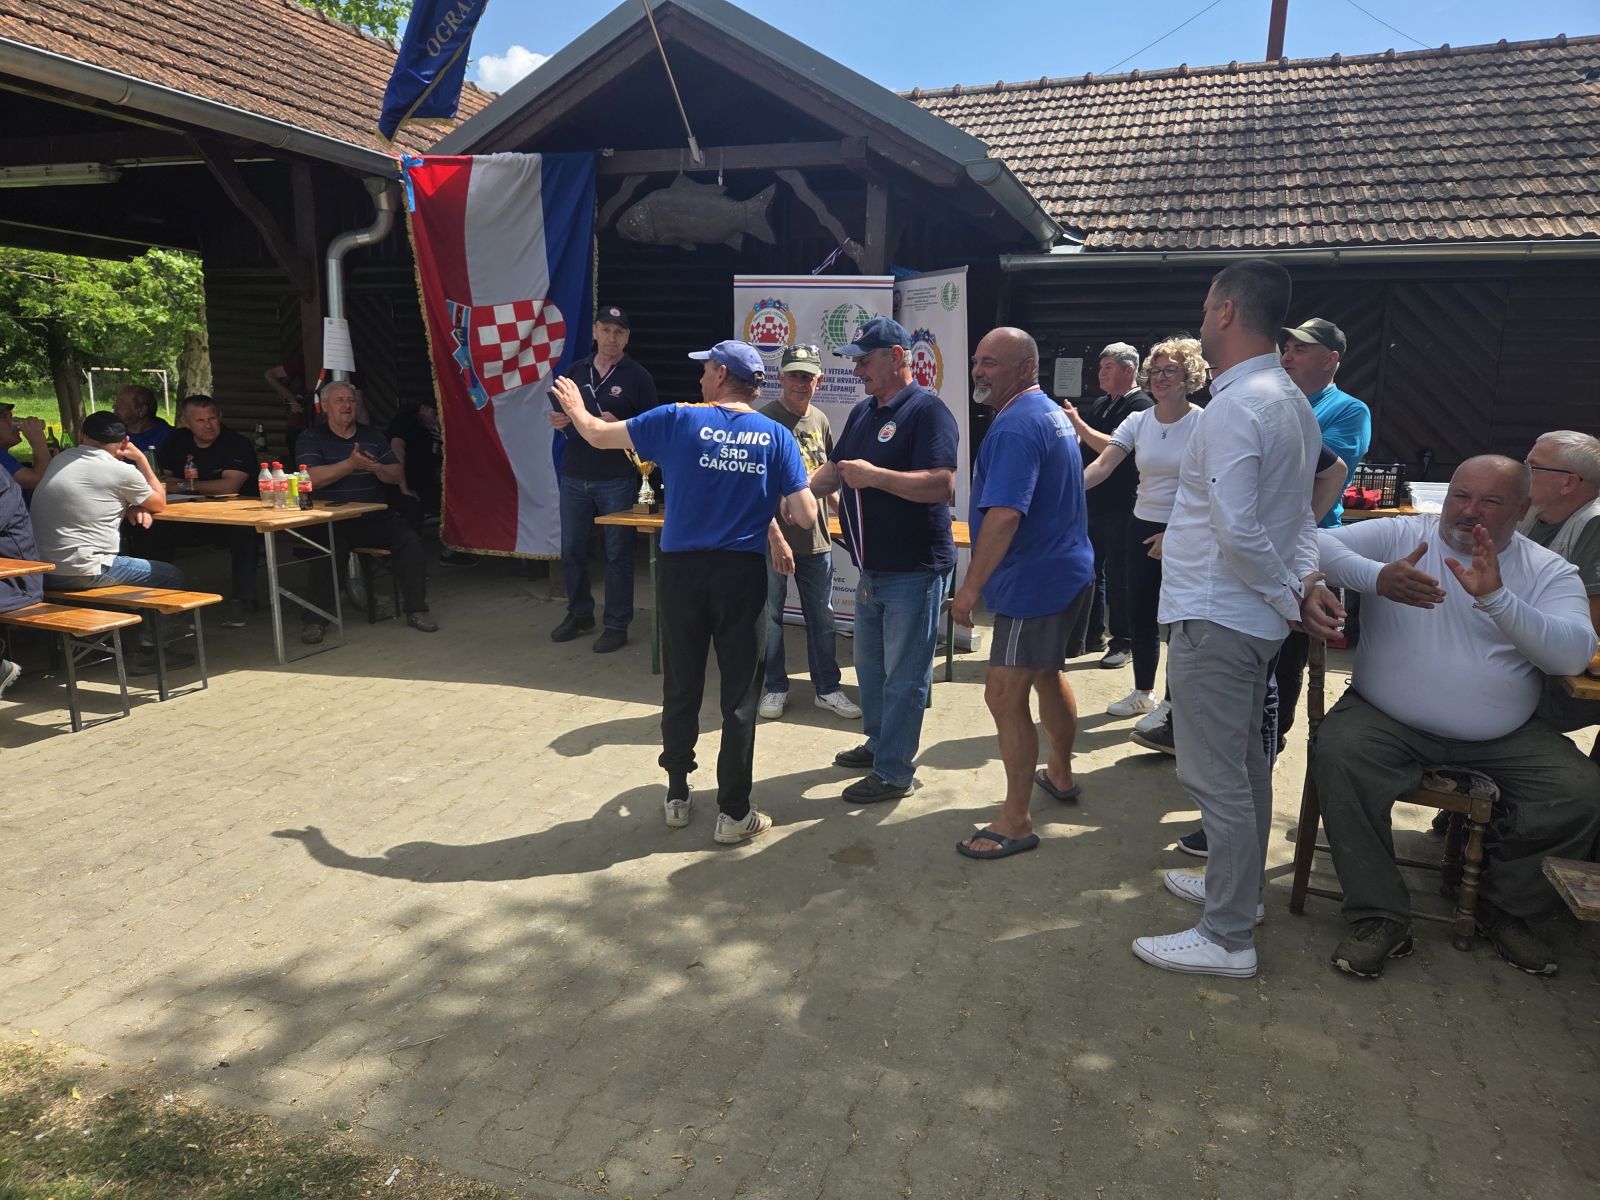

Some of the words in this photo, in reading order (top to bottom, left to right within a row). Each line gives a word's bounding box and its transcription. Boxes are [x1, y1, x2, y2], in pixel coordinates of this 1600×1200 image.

[427, 0, 476, 57] OGRA
[830, 383, 856, 393] ŽUPANIJE
[700, 426, 771, 446] COLMIC
[720, 445, 748, 460] ŠRD
[699, 453, 767, 475] ČAKOVEC
